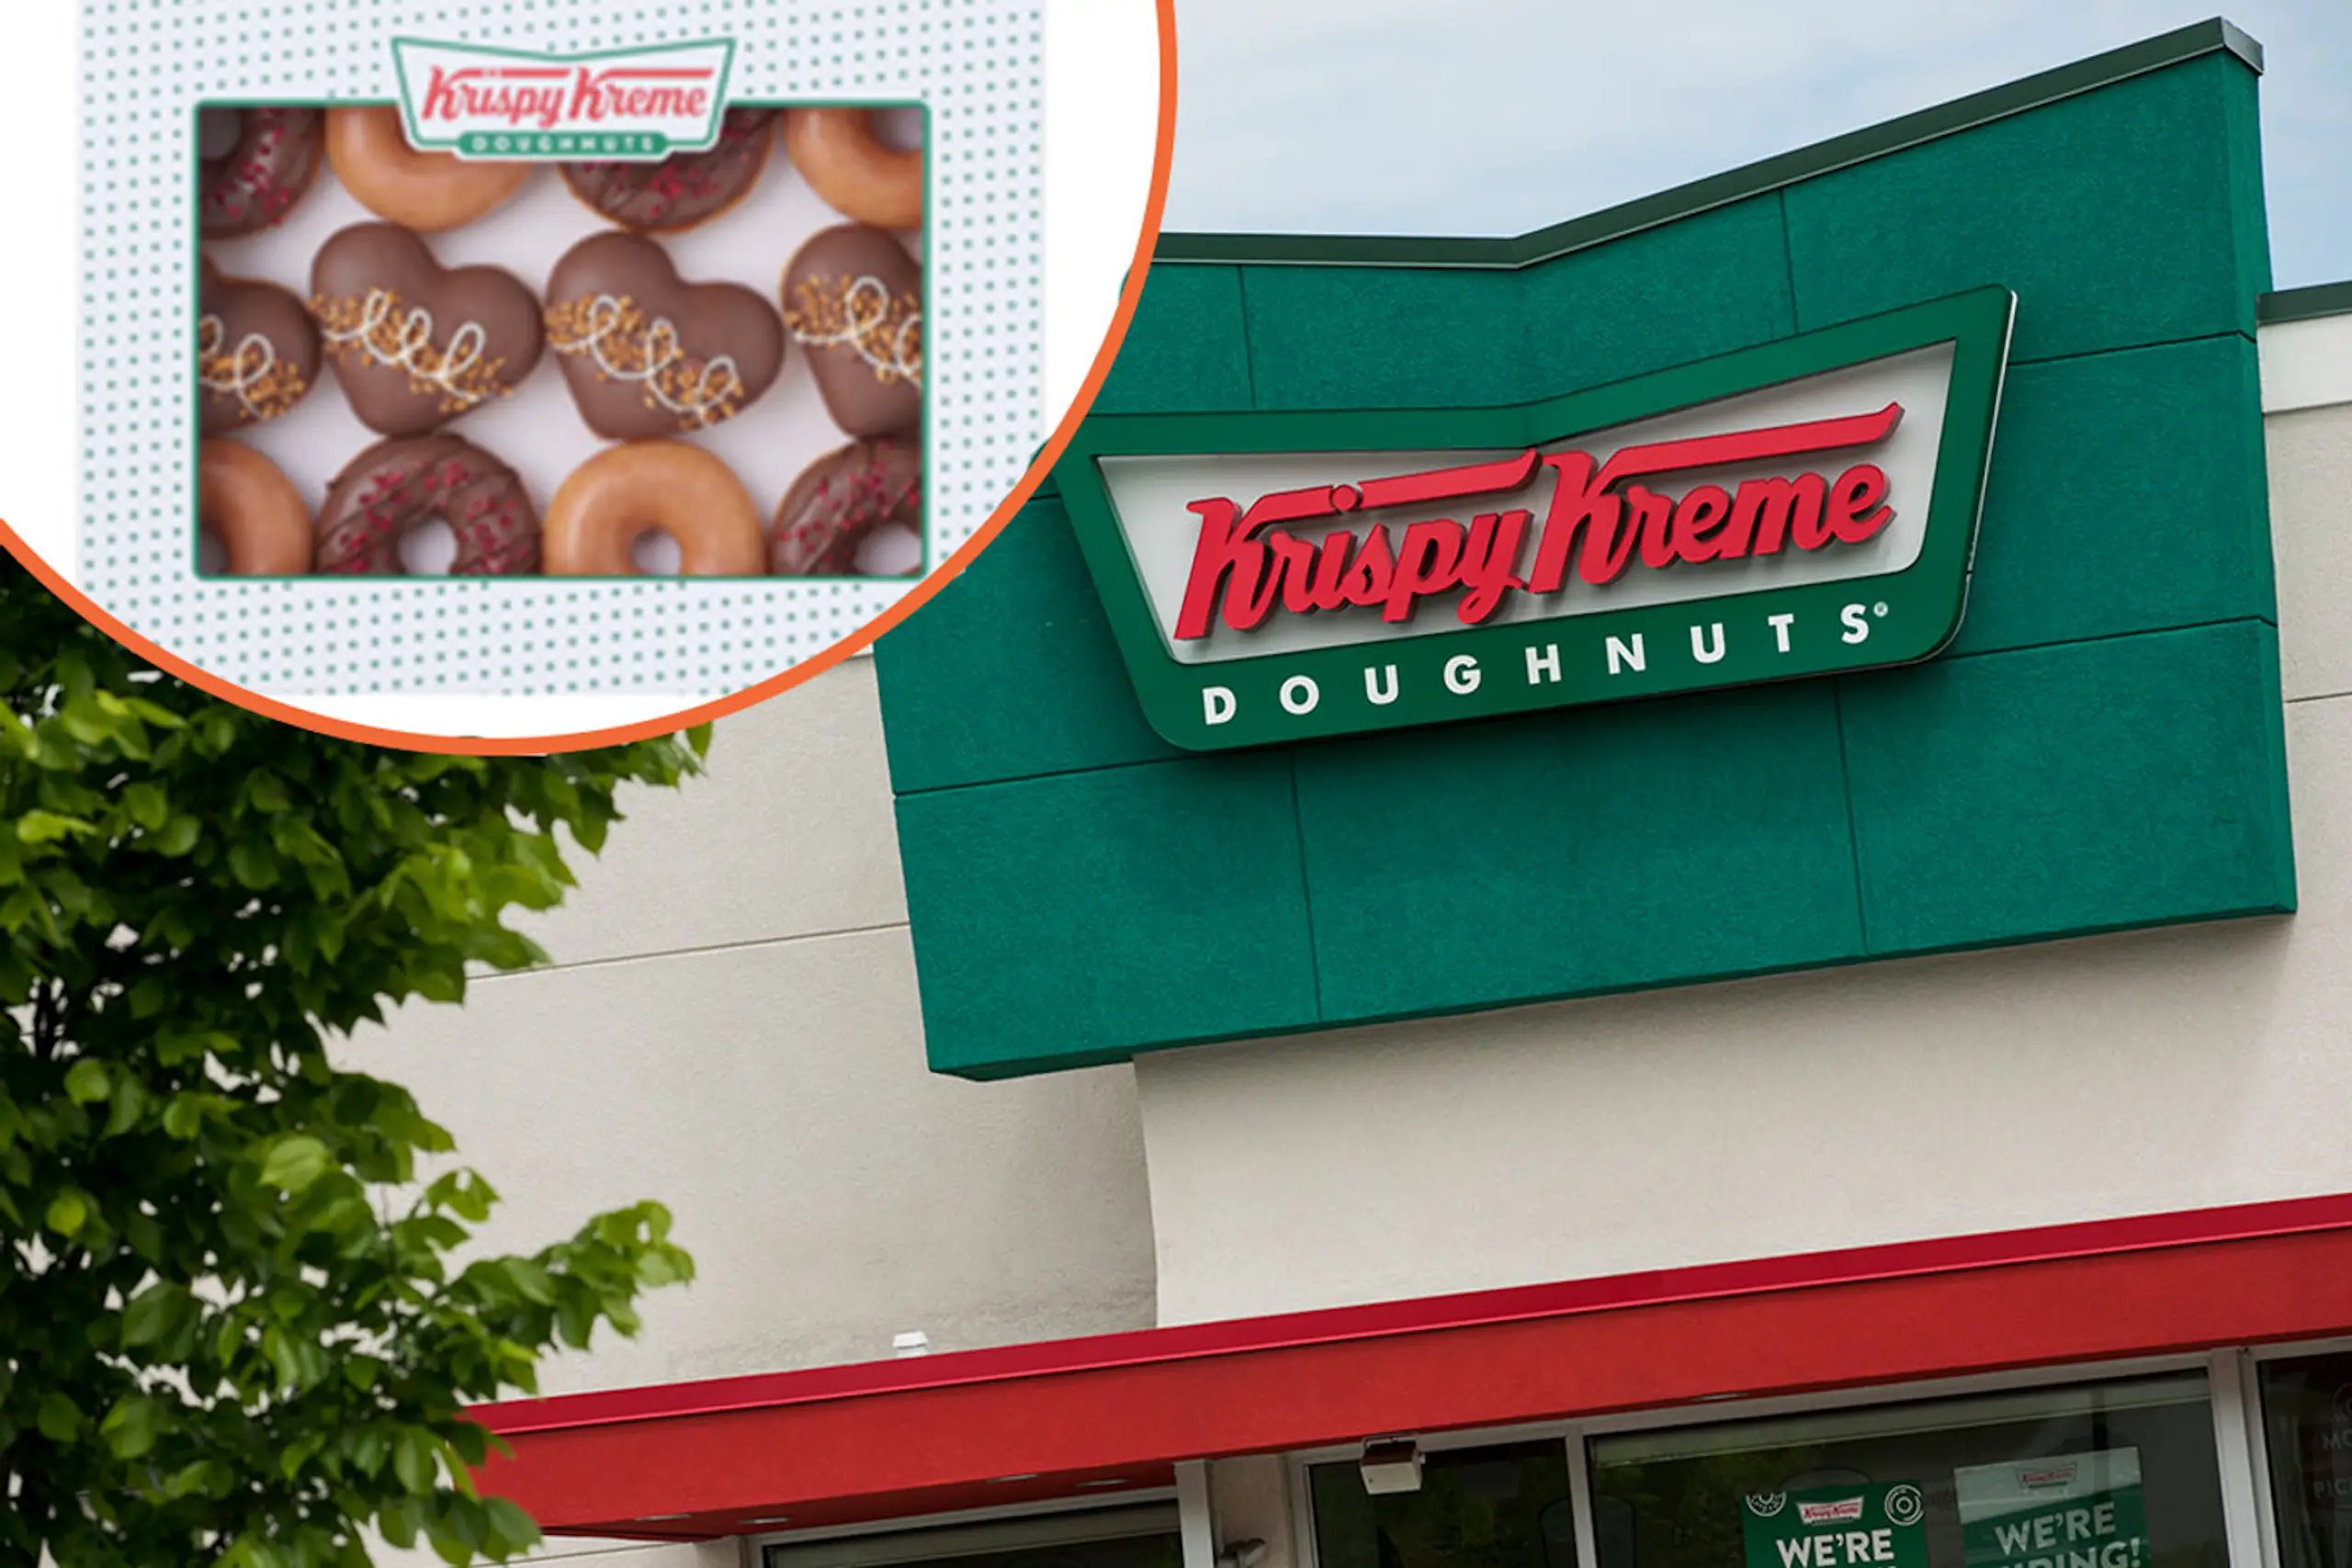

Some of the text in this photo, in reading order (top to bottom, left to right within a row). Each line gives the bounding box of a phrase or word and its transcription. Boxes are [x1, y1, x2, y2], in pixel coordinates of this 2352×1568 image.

[421, 65, 714, 130] Krispy Kreme
[1173, 400, 1905, 641] Krispy Kreme
[1776, 1529, 1894, 1568] WE'RE
[1995, 1502, 2116, 1556] WE'RE
